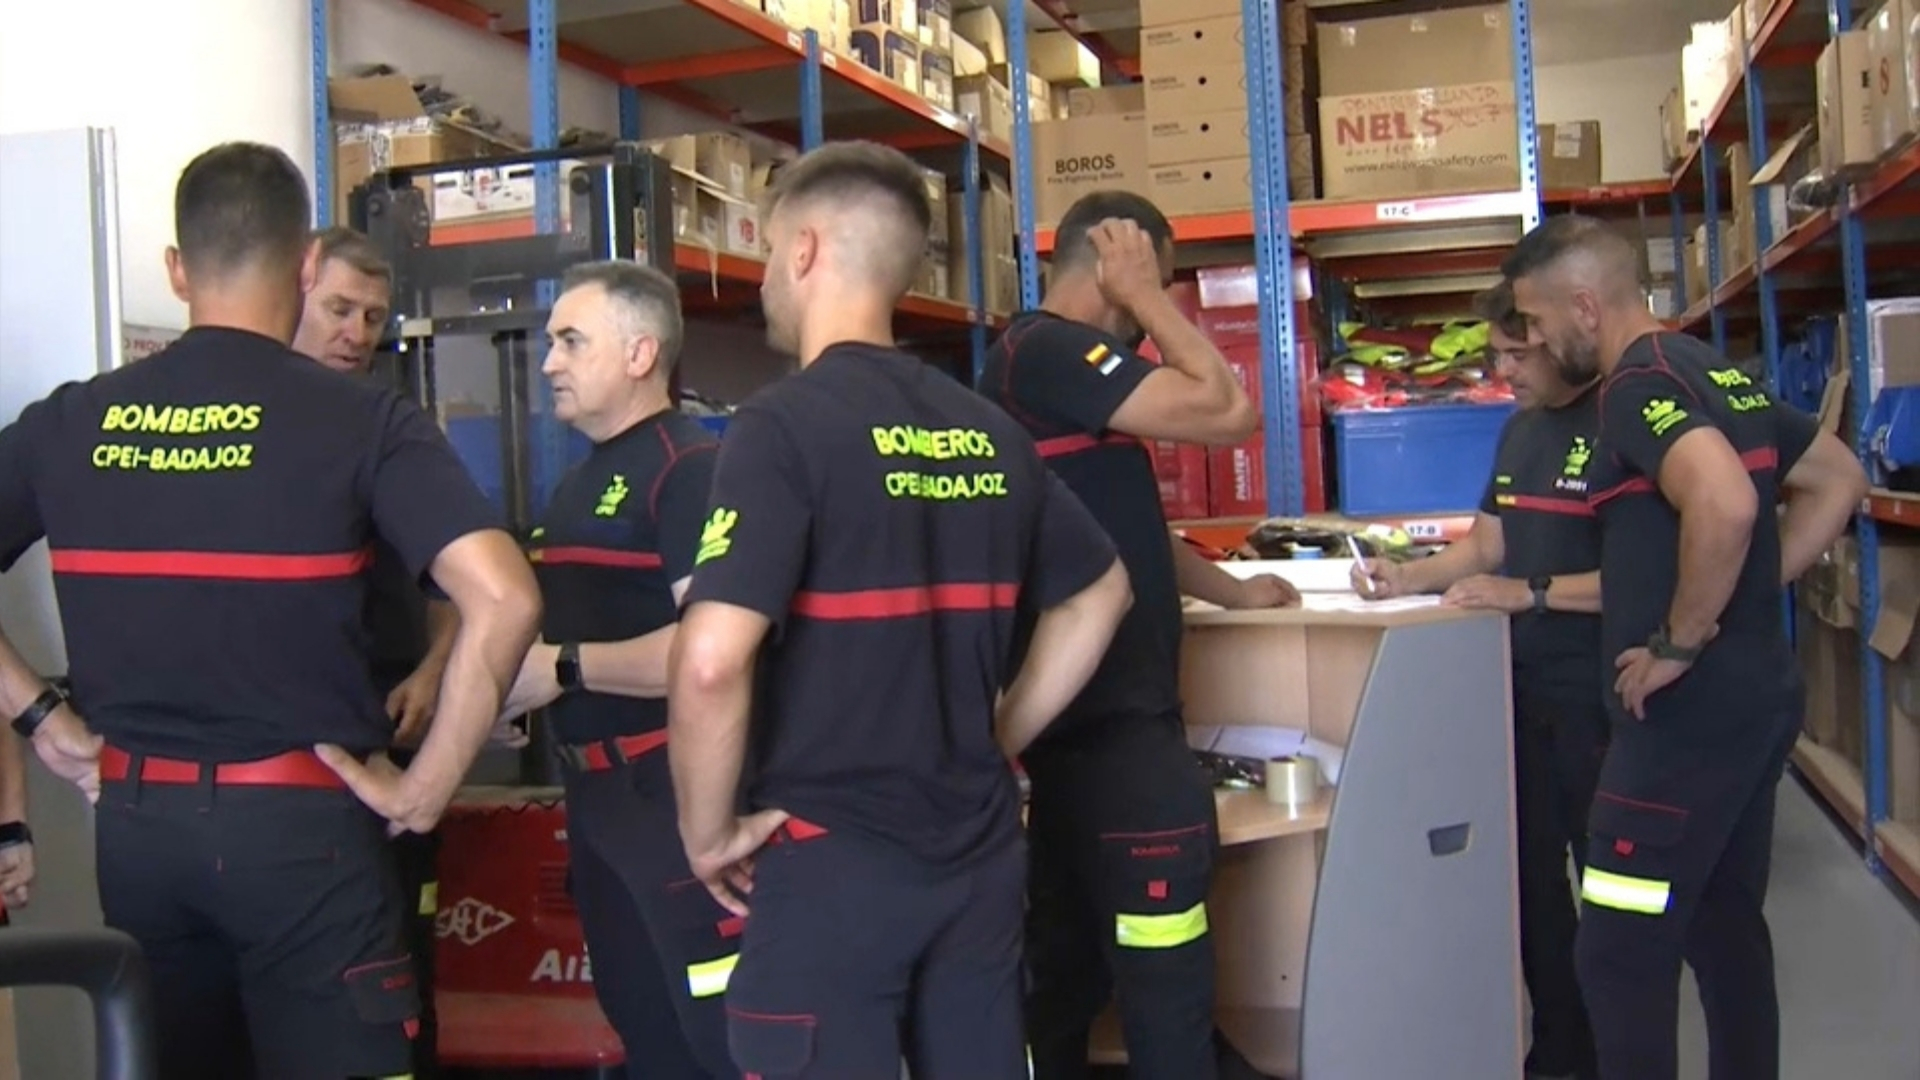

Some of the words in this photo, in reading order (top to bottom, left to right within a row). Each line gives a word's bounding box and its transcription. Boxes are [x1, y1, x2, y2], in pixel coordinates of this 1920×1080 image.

[1055, 153, 1115, 174] BOROS
[1383, 205, 1410, 217] 17-C
[102, 403, 262, 433] BOMBEROS
[872, 425, 995, 459] BOMBEROS
[92, 443, 253, 470] CPEI-BADAJOZ
[885, 471, 1008, 498] CPEBADAJOZ
